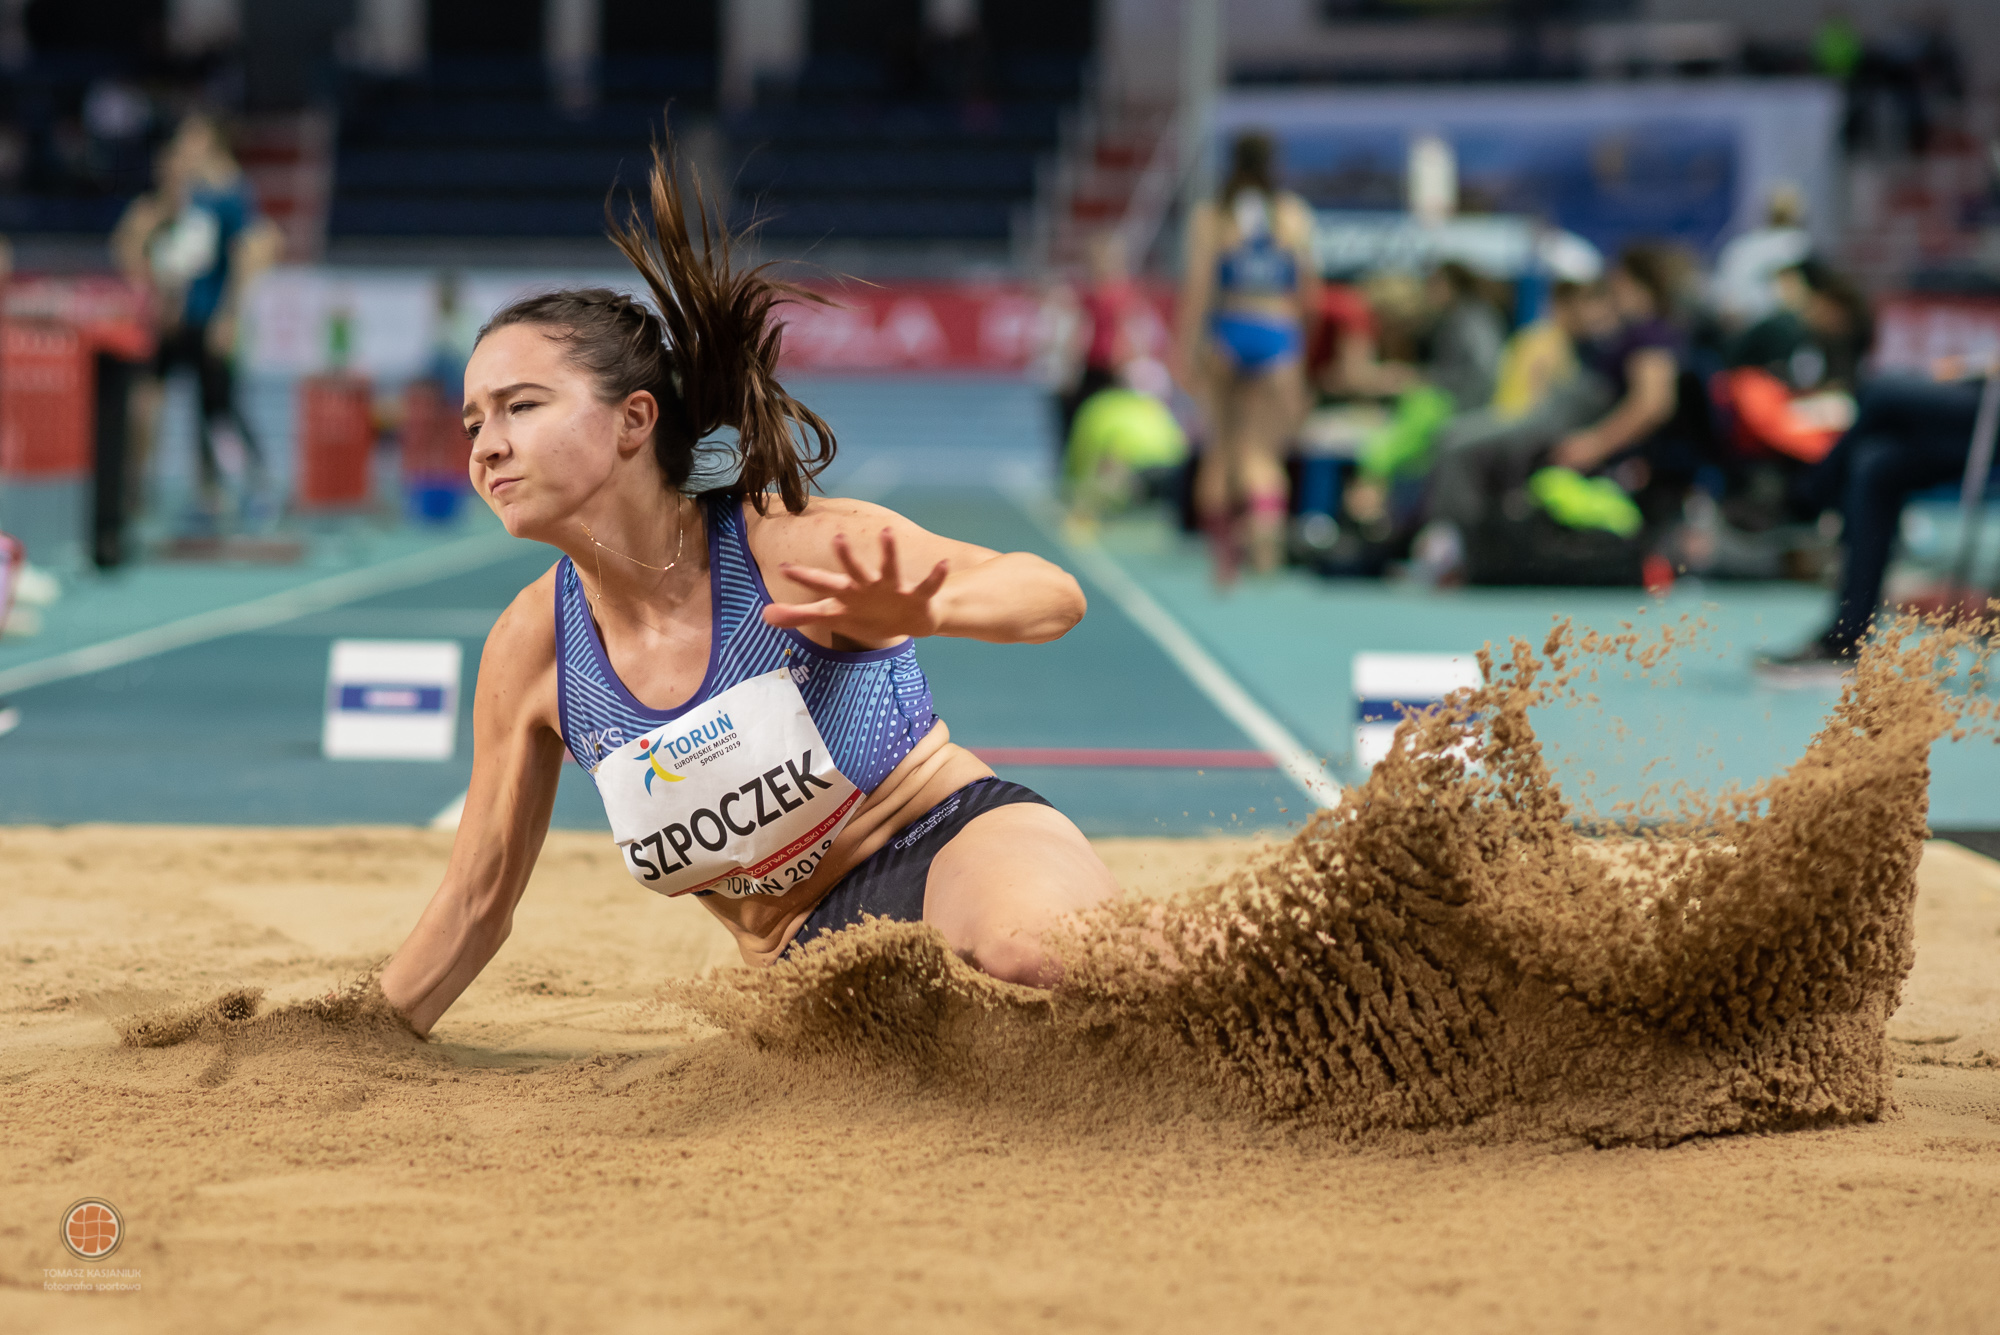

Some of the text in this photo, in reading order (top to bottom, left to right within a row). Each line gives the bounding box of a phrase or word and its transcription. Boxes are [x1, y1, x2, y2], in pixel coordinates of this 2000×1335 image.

[579, 727, 625, 762] MKS
[663, 709, 734, 760] TORUŃ
[674, 732, 738, 770] EUROPEJSKIE MIASTO
[700, 740, 741, 767] SPORTU 2019
[629, 749, 834, 881] SZPOCZEK
[786, 831, 820, 855] POLSKI
[836, 799, 853, 818] U20
[894, 798, 961, 850] Czechowice
